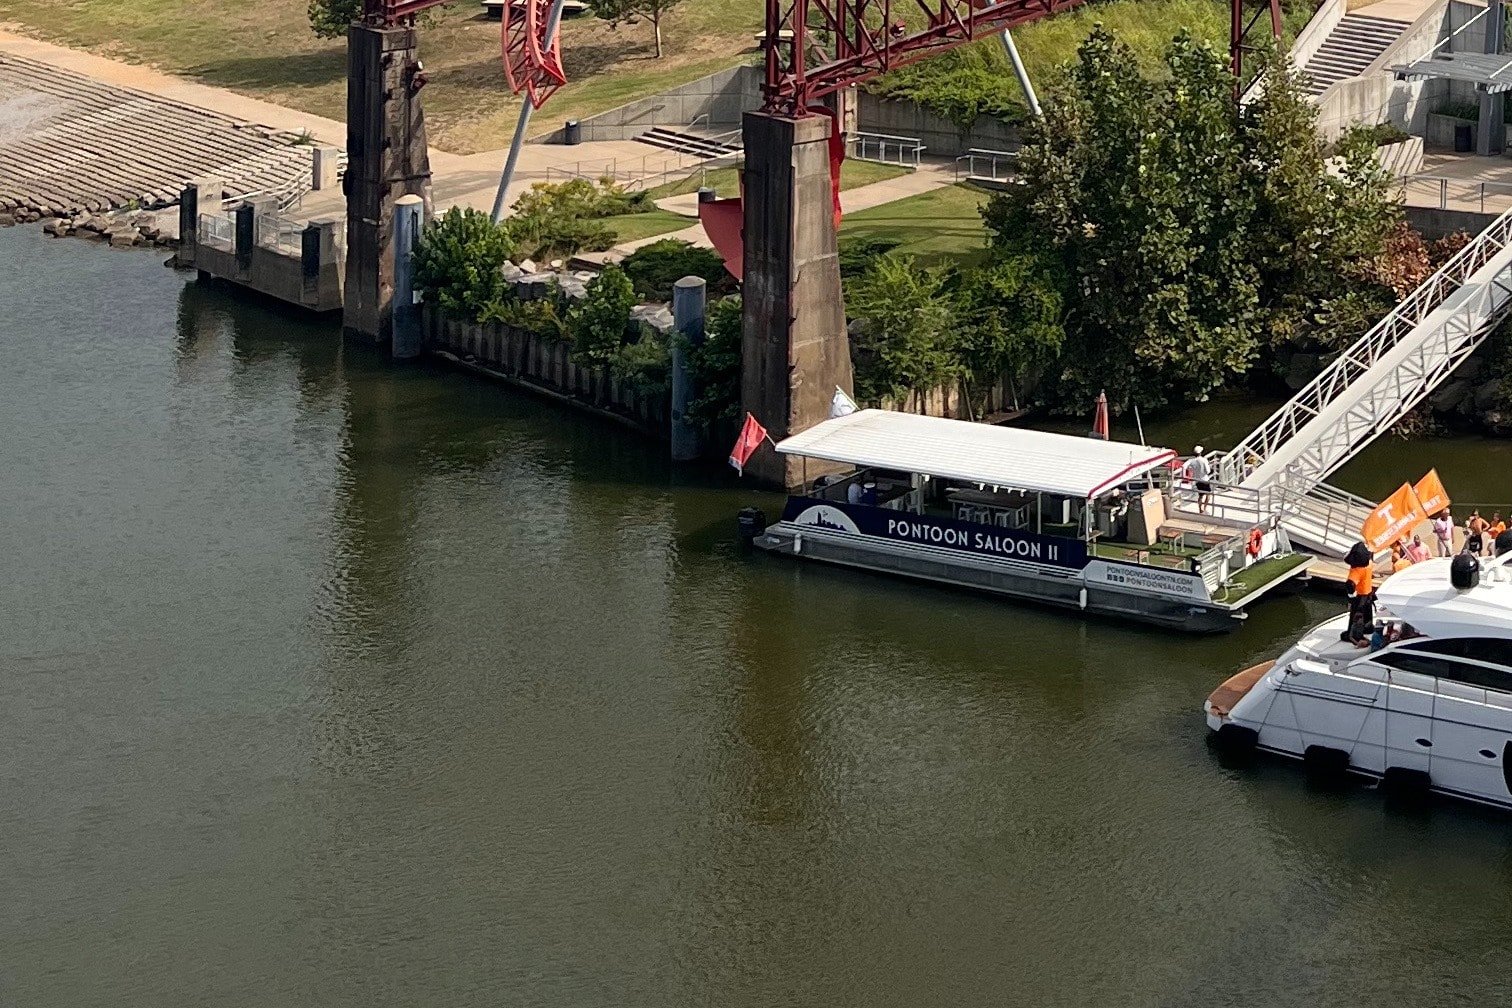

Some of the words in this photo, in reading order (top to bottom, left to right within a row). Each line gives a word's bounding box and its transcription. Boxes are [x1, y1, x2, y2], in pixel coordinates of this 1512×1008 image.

[888, 519, 968, 547] PONTOON
[975, 533, 1041, 558] SALOON
[1125, 576, 1193, 594] PONTOONSALOON
